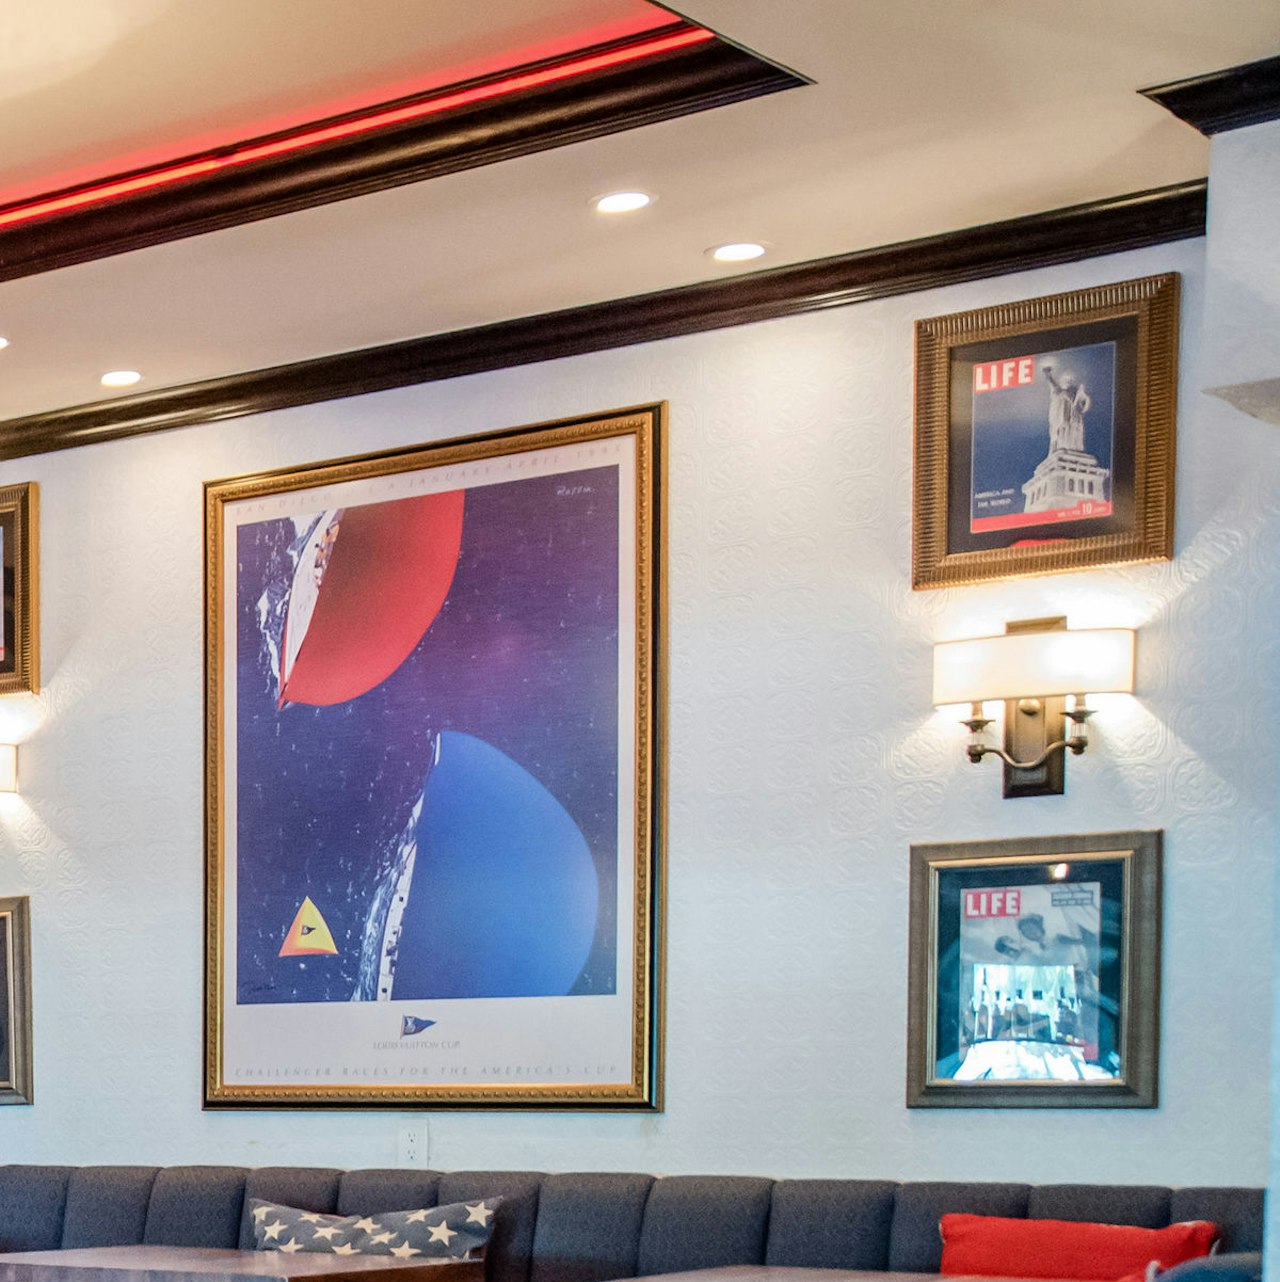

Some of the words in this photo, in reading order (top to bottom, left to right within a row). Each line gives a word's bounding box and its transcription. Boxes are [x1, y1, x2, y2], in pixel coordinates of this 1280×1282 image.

[976, 360, 1031, 390] LIFE
[1083, 503, 1092, 514] 10
[967, 892, 1018, 915] LIFE
